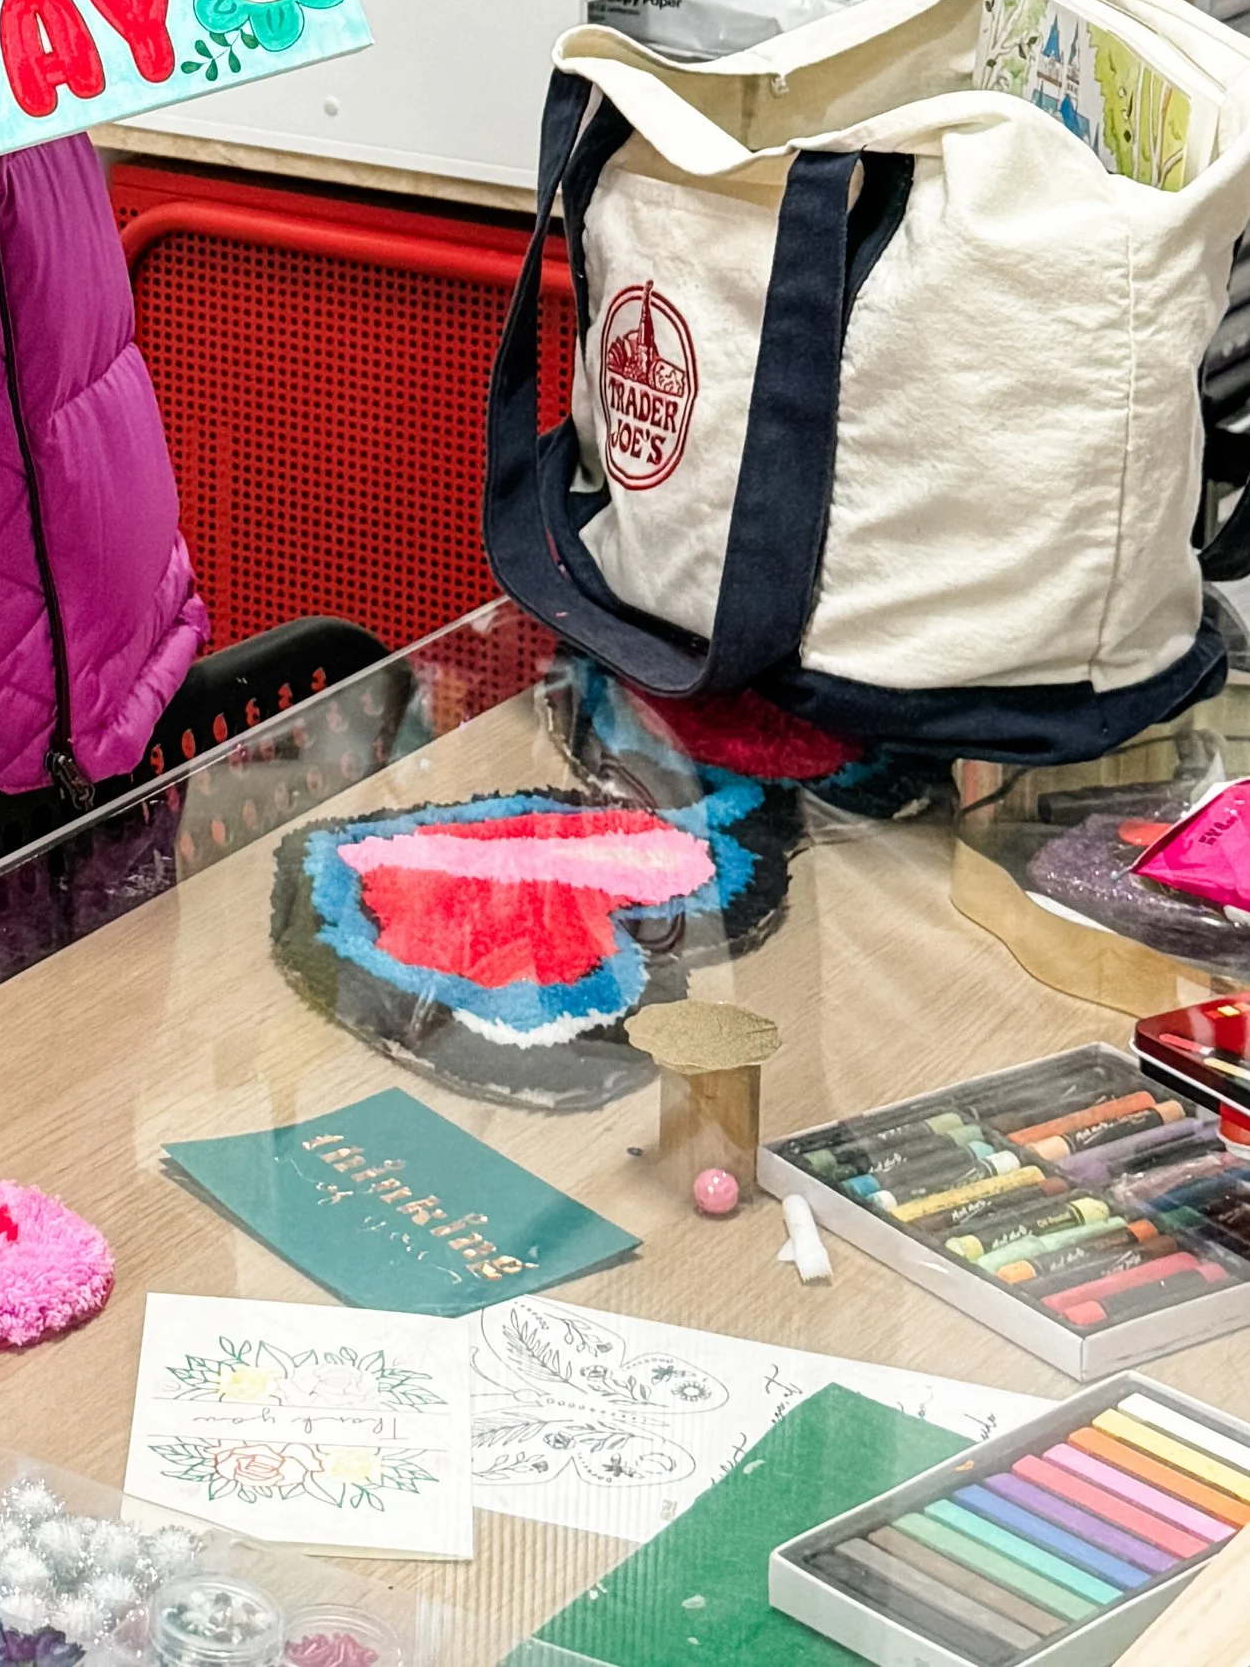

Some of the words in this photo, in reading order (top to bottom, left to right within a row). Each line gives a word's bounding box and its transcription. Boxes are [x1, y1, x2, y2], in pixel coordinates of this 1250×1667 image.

[608, 377, 679, 433] TRADER
[611, 419, 667, 465] JOE'S
[193, 1406, 277, 1424] you
[291, 1416, 410, 1440] Thank
